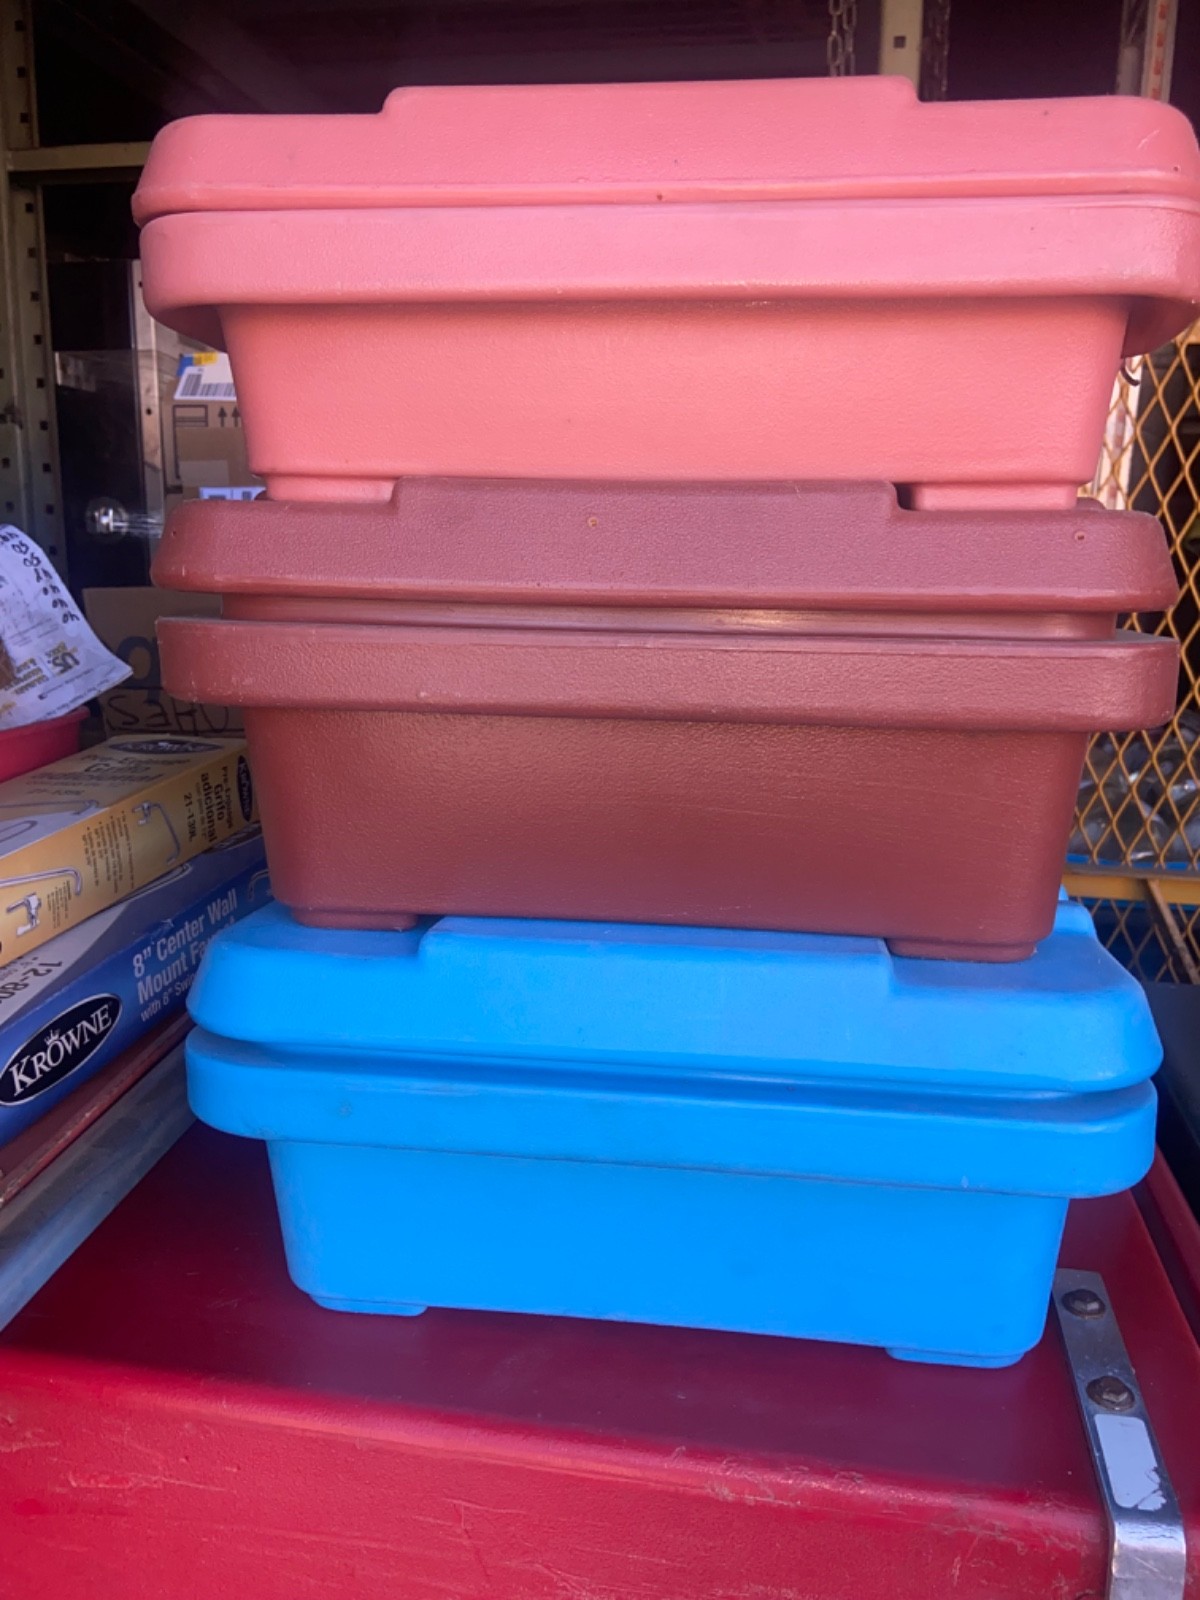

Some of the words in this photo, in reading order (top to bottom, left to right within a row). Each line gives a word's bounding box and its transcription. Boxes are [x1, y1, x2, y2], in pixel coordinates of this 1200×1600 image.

[157, 913, 206, 961] Center
[207, 887, 238, 925] Wall
[0, 957, 63, 1005] 12-80
[137, 951, 189, 1005] Mount
[140, 998, 162, 1022] with
[8, 1004, 112, 1097] KROWNE
